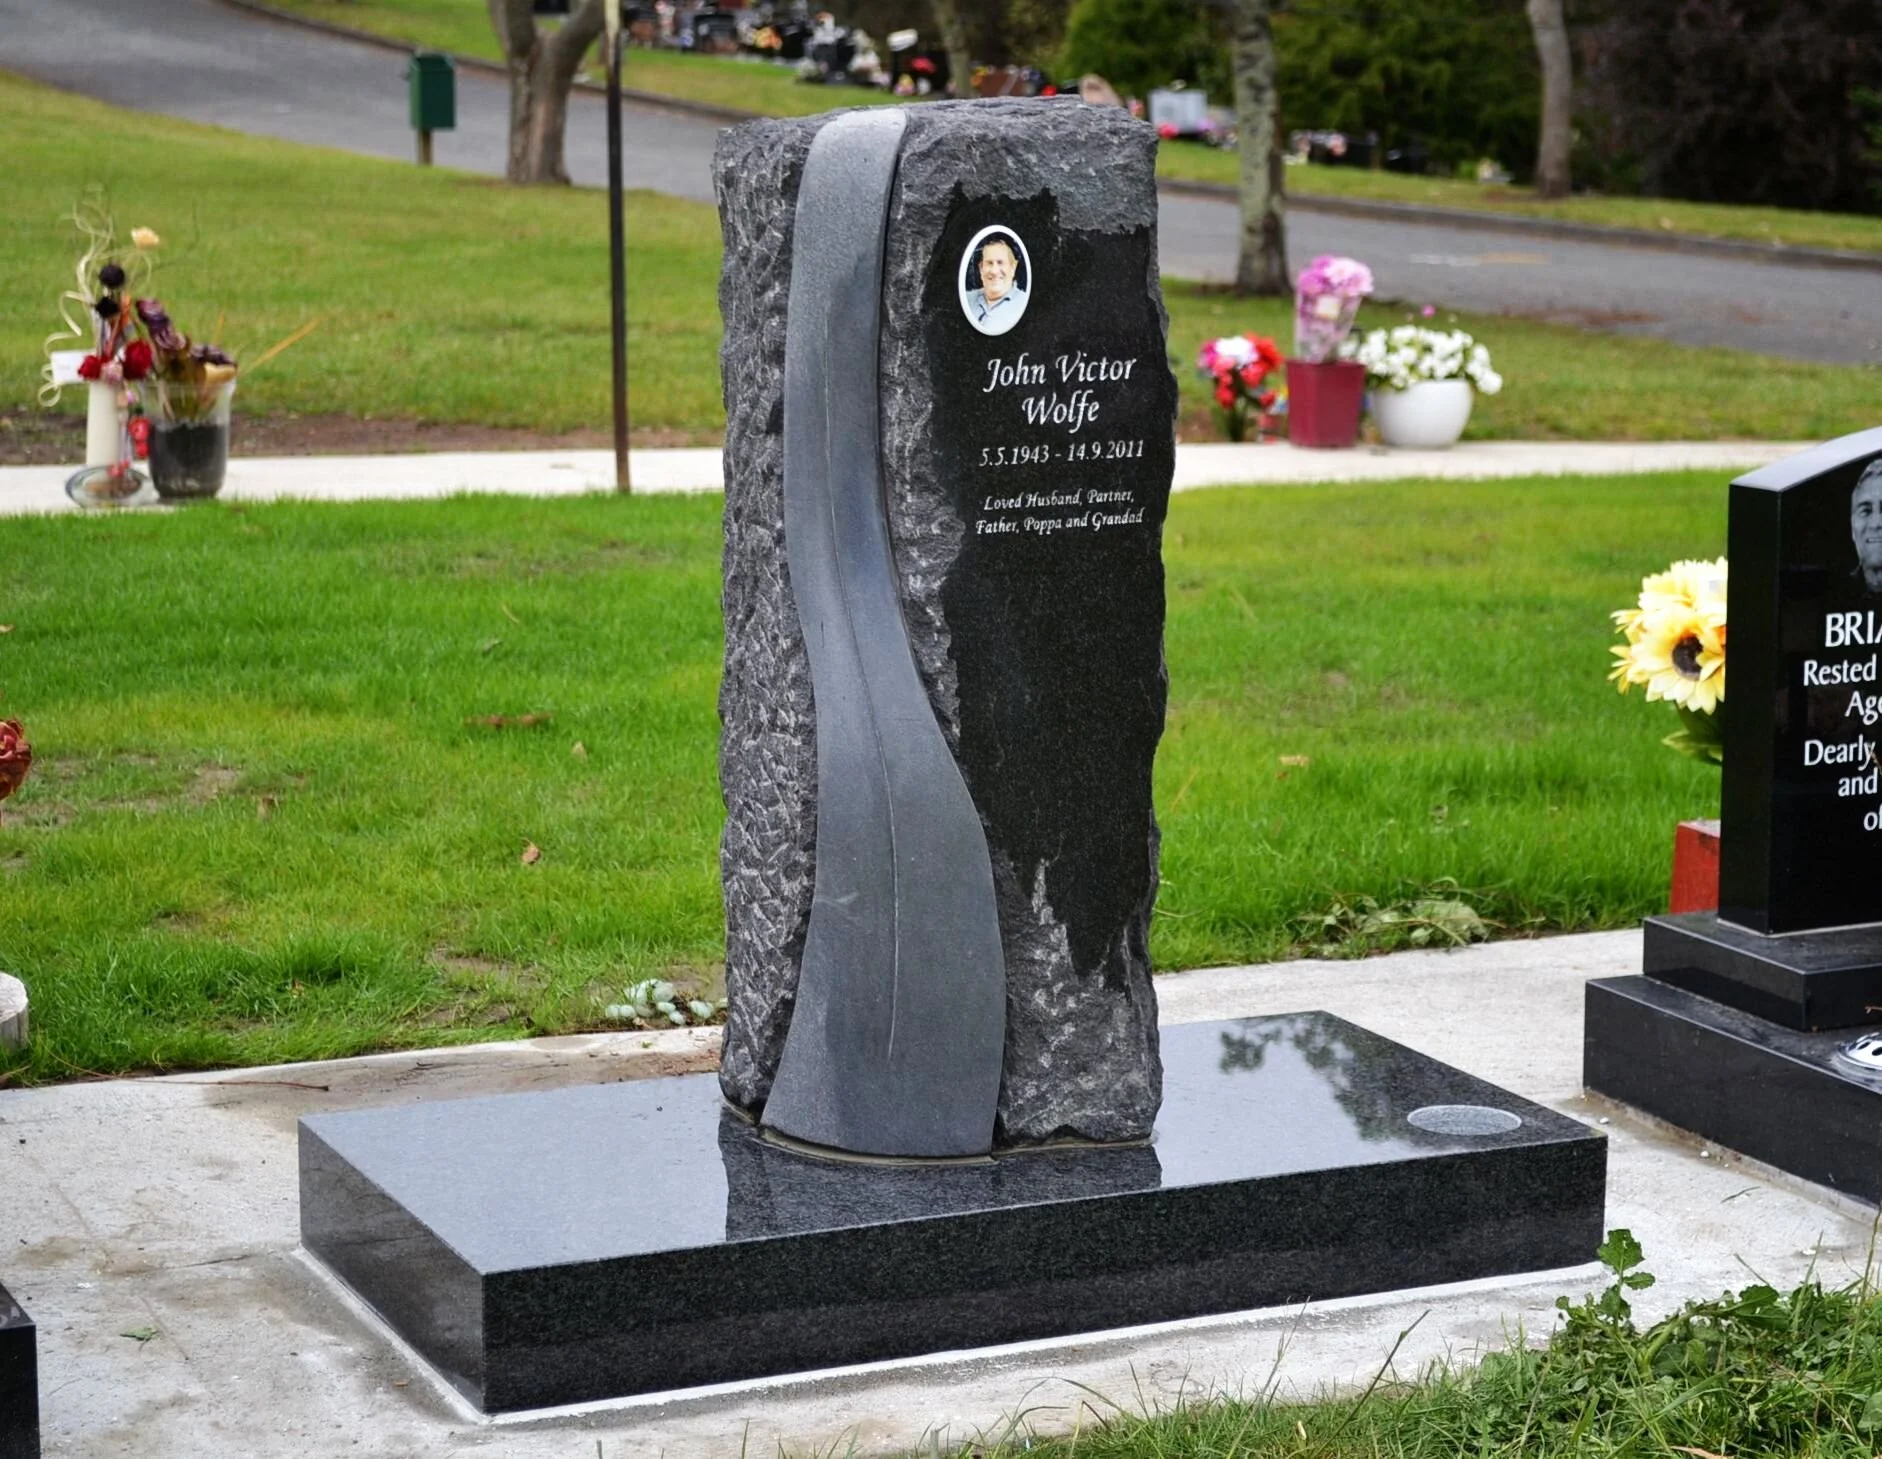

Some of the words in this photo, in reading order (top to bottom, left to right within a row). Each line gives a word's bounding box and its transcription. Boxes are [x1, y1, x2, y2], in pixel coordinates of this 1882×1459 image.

[982, 353, 1046, 393] John
[1055, 351, 1137, 383] Victor
[1021, 389, 1100, 434] Wolfe
[979, 445, 1050, 467] 5.5.1943
[1067, 440, 1144, 462] 14.9.2011
[984, 493, 1023, 511] Loved
[1025, 488, 1083, 508] Husband,
[1087, 489, 1134, 504] Partner,
[976, 516, 1020, 534] Father,
[1023, 516, 1062, 535] Poppa
[1065, 511, 1090, 528] and
[1092, 507, 1145, 532] Grandad
[1825, 610, 1882, 648] BRI
[1803, 652, 1877, 686] Rested
[1804, 734, 1876, 771] Dearly
[1838, 767, 1878, 797] and
